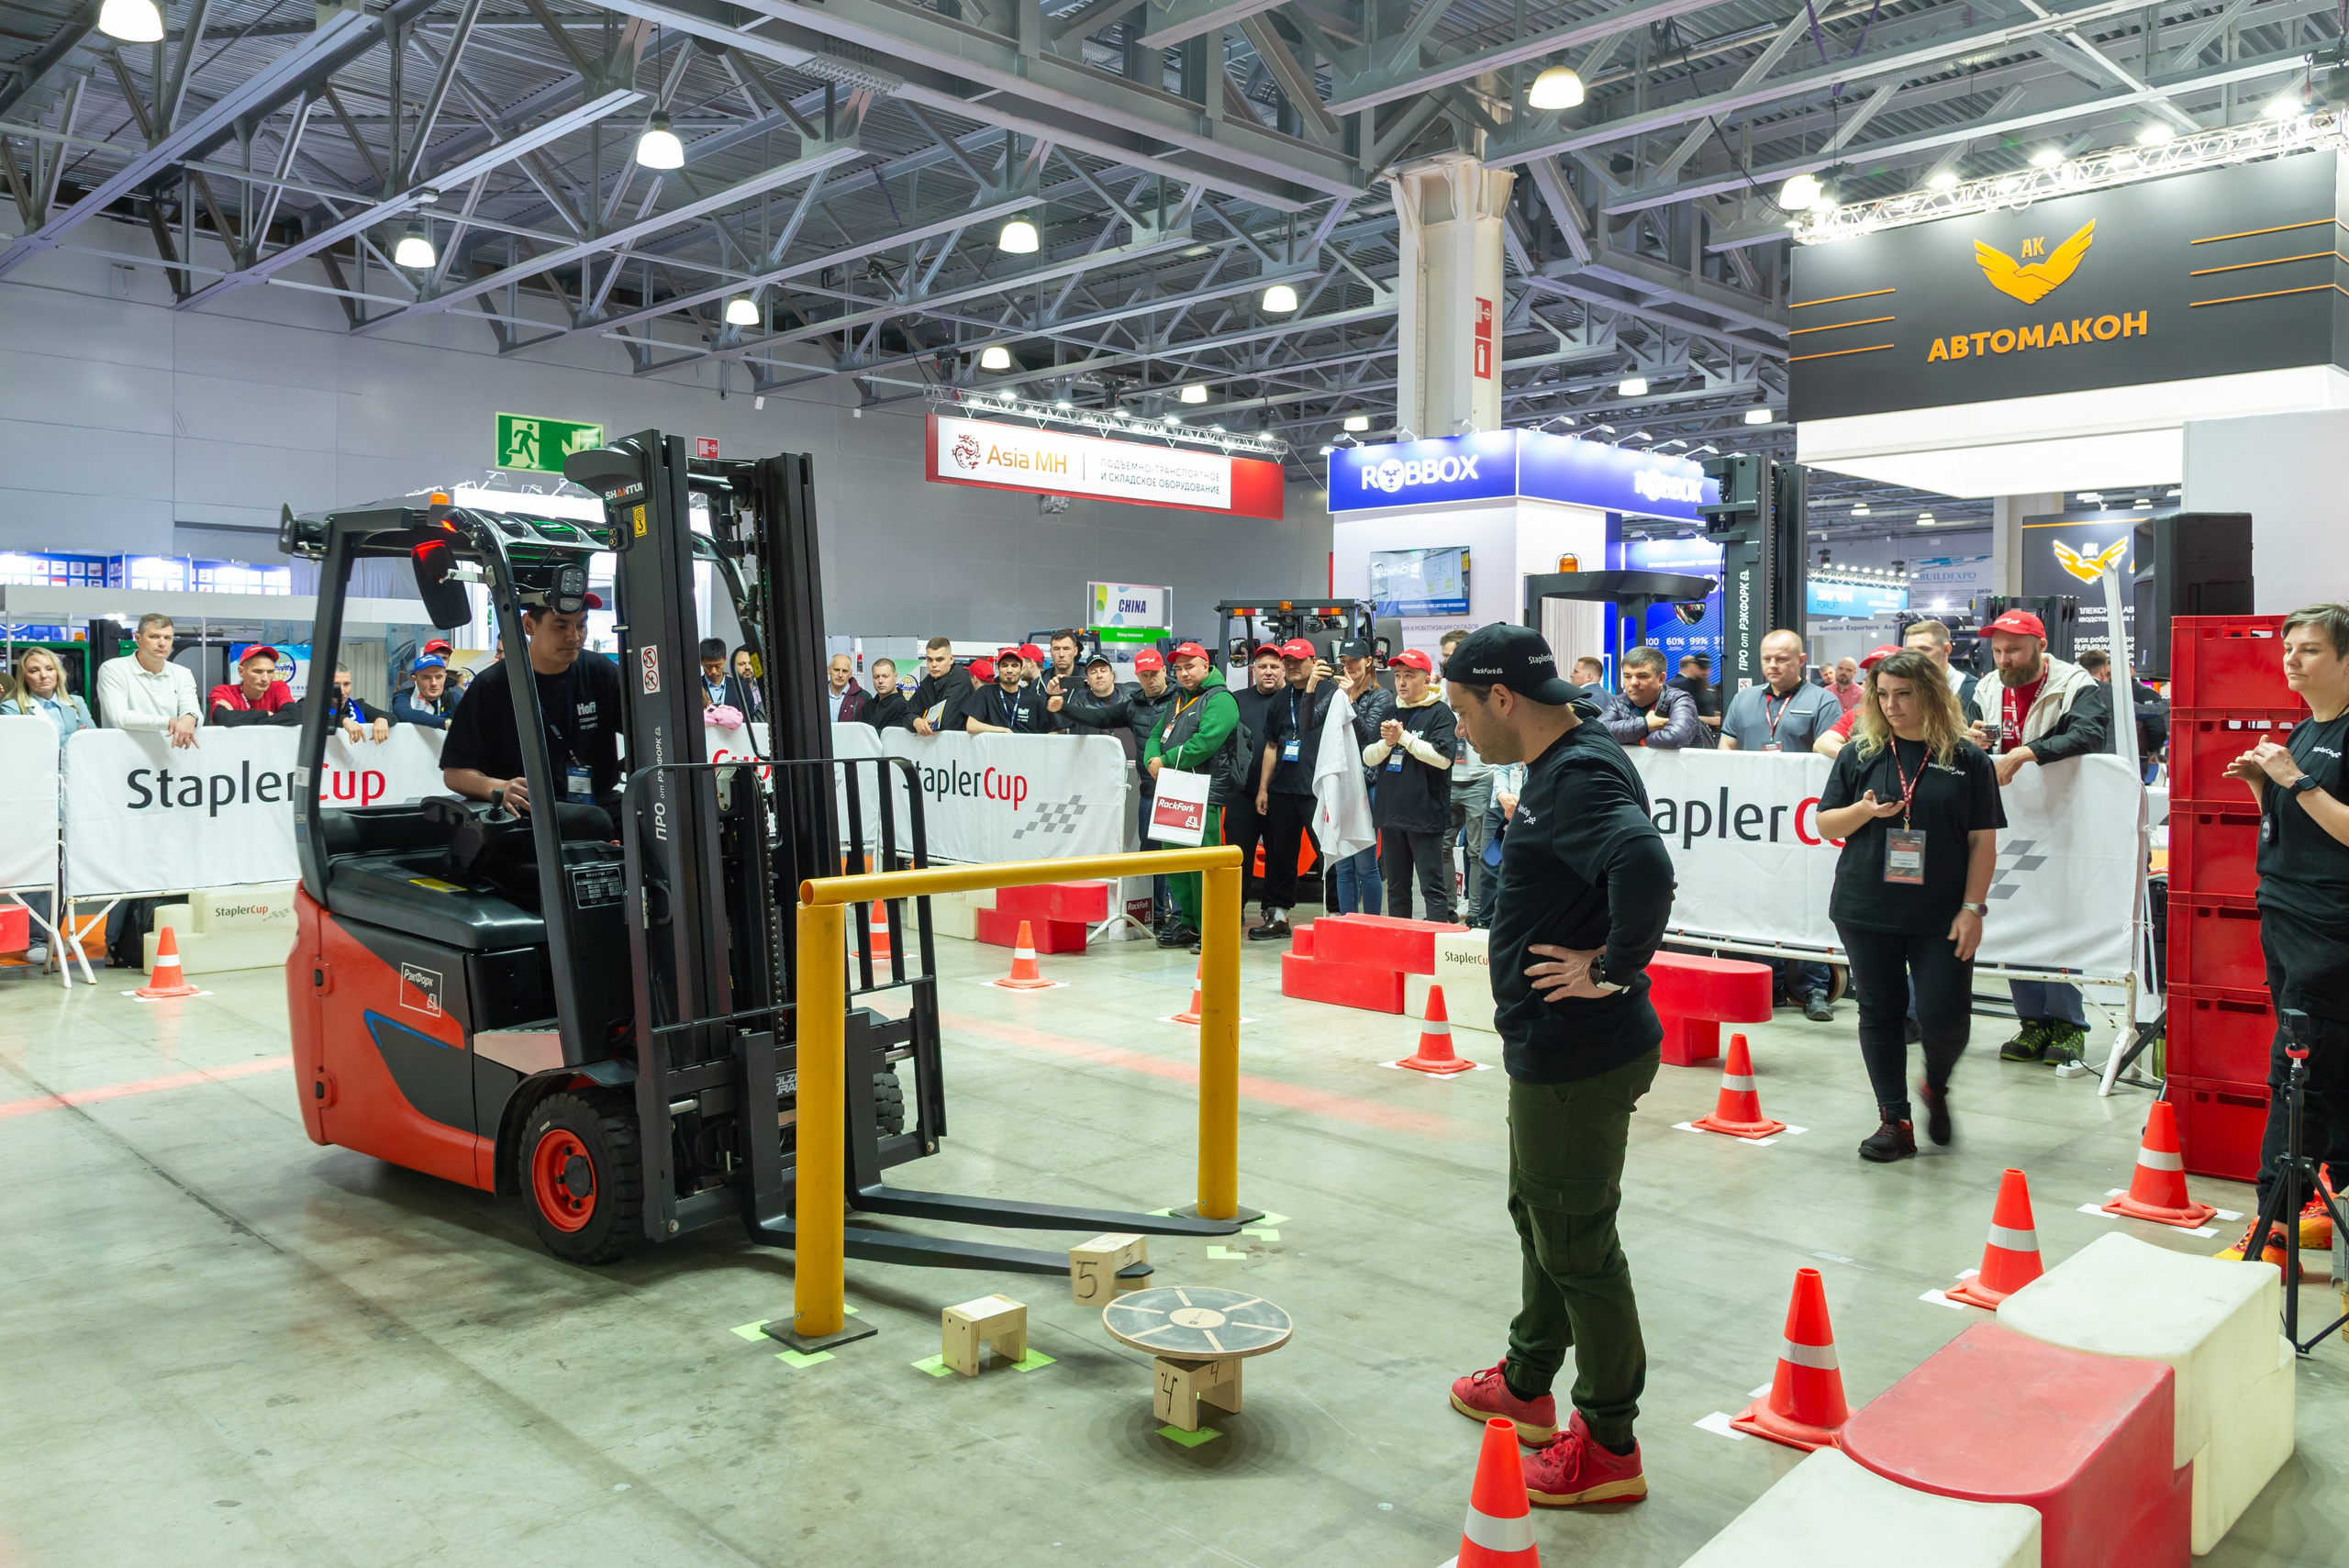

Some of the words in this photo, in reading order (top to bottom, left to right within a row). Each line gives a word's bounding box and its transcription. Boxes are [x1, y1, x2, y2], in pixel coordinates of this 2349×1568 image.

[1927, 310, 2148, 363] АВТОМАКОН
[987, 444, 1030, 469] Asia
[1035, 450, 1067, 474] MH
[1101, 458, 1220, 483] ПОДЪЕМНО-ТРАНСПОРТНОЕ
[1362, 454, 1479, 493] ROBBOX
[606, 482, 643, 501] SHANTUI
[1101, 473, 1108, 482] И
[1109, 473, 1157, 488] СКЛАДСКОЕ
[1158, 478, 1220, 495] ОБОРУДОВАНИЕ
[1119, 599, 1146, 614] CHINA
[1739, 582, 1750, 631] РЭКФОРК
[1415, 624, 1453, 632] РОБОТИЗАЦИЯ
[1666, 637, 1685, 646] 60%
[1689, 637, 1709, 645] 99%
[1741, 632, 1750, 648] от
[1472, 667, 1497, 675] RackFork
[1738, 651, 1749, 672] ПРО
[660, 784, 665, 799] от
[1157, 798, 1196, 813] RackFork
[653, 802, 668, 841] ПРО
[216, 905, 269, 917] StaplerCup
[1128, 900, 1149, 911] RackFork
[403, 968, 434, 988] РэкФорк
[1076, 1260, 1099, 1299] 5
[1210, 1362, 1219, 1384] 4
[1162, 1372, 1176, 1416] 4
